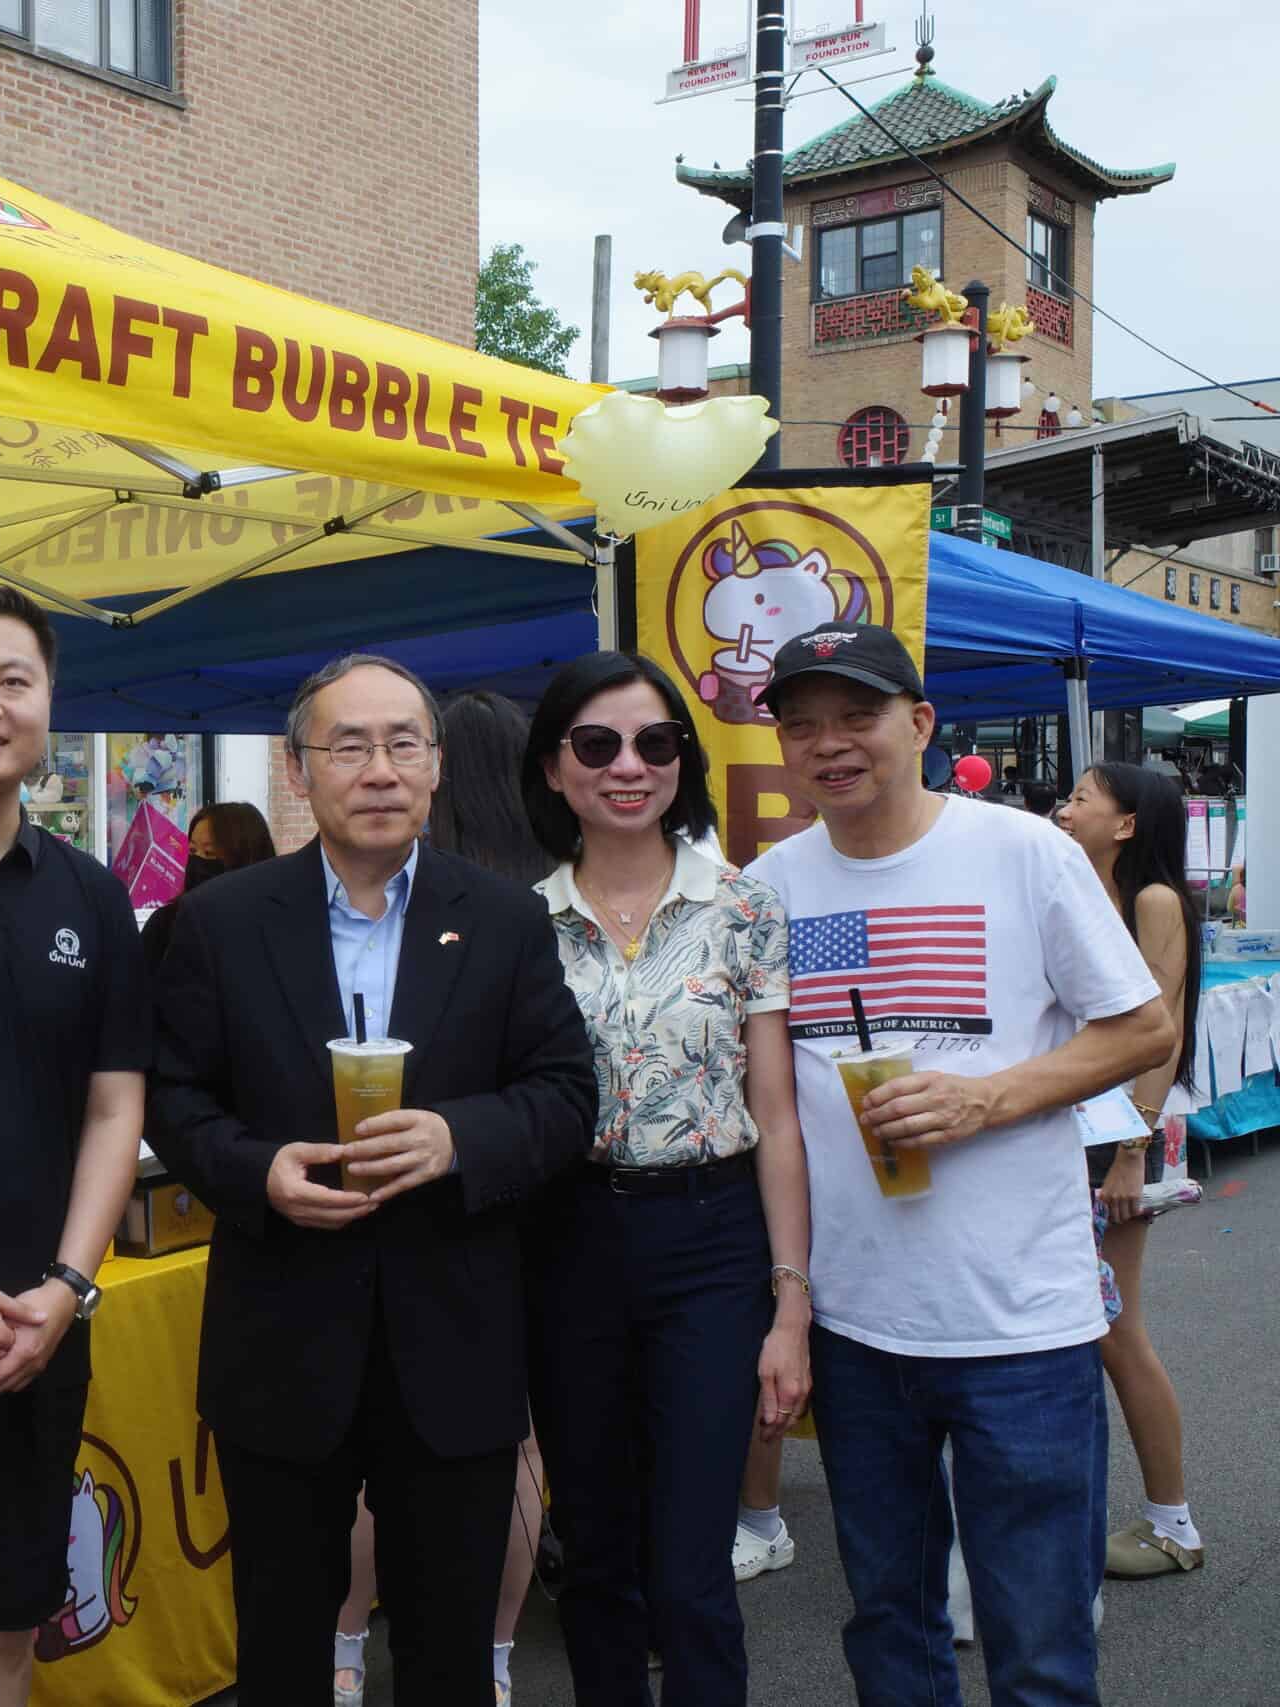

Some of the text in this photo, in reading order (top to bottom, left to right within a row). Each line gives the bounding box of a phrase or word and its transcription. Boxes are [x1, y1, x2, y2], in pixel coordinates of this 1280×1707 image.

[815, 31, 862, 49] NEW SUN
[805, 40, 870, 62] FOUNDATION
[687, 61, 729, 77] NEW SUN
[679, 70, 737, 89] FOUNDATION
[232, 325, 487, 458] BUBBLE
[500, 395, 574, 476] TE
[804, 1019, 960, 1035] UNITED STTES OF AMERICA
[936, 1036, 981, 1051] 1776
